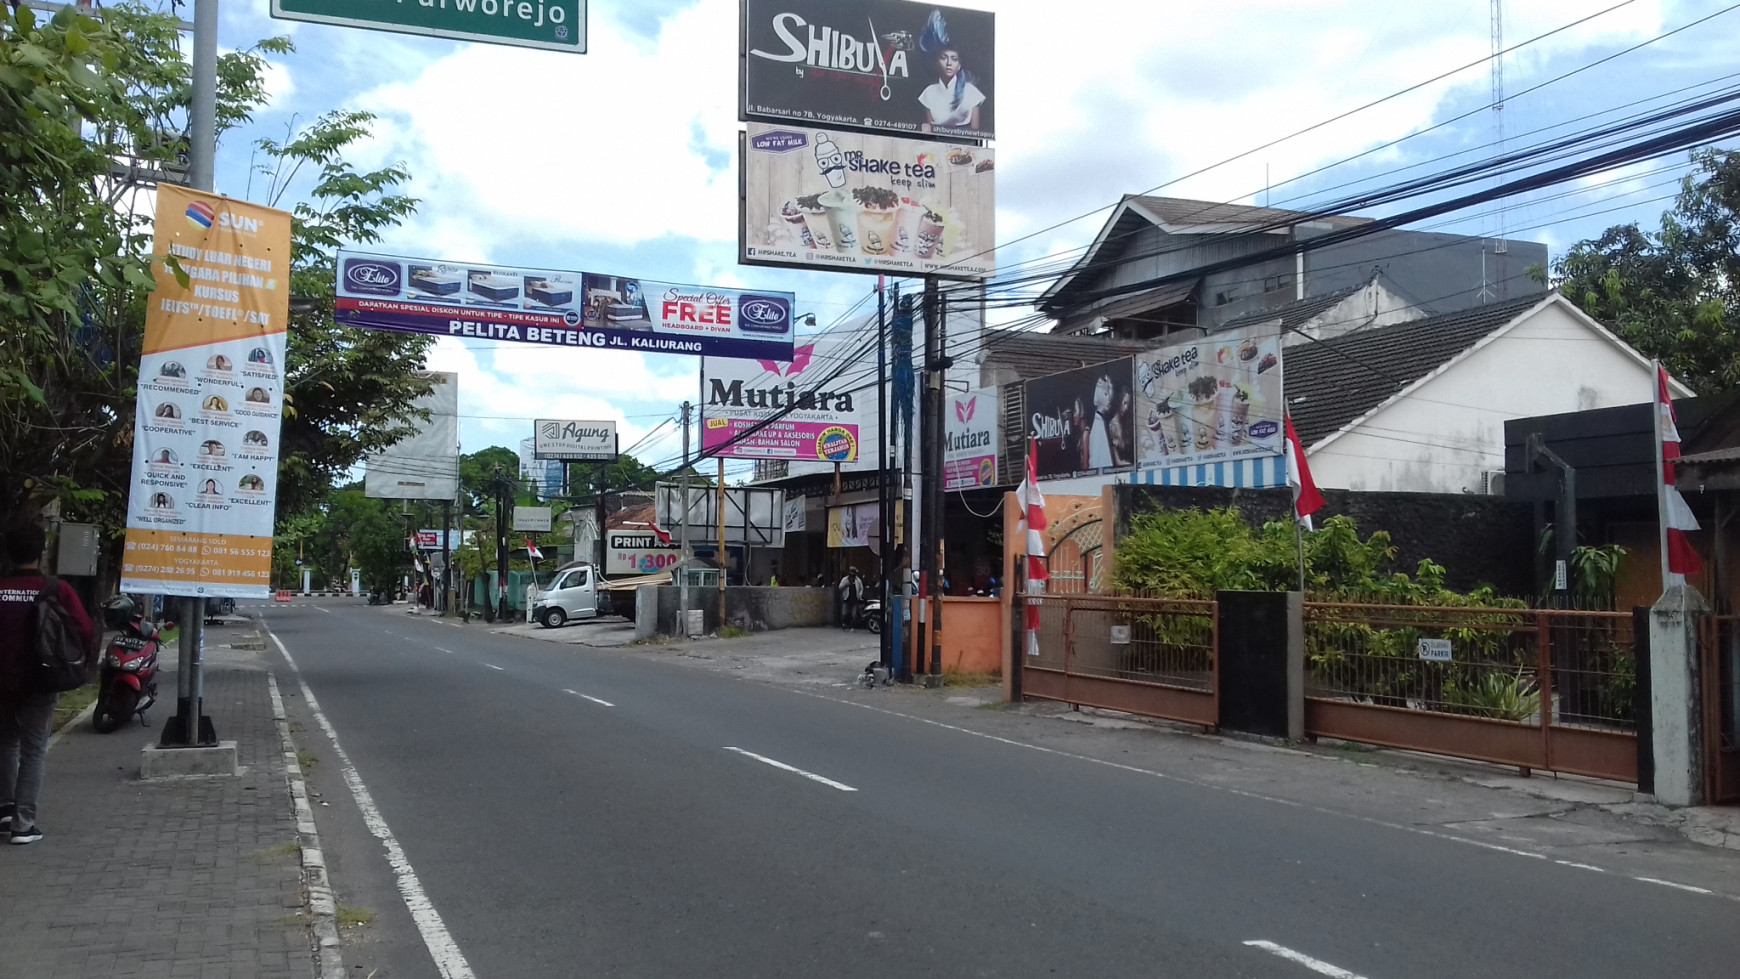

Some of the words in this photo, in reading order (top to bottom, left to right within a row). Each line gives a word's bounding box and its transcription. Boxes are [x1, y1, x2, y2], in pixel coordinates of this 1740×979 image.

[796, 66, 804, 78] by
[757, 106, 790, 115] Babarsari
[904, 163, 936, 179] tea
[890, 175, 912, 191] keep
[917, 178, 936, 189] slim
[204, 250, 232, 266] LUAR
[234, 254, 272, 273] NEGERI
[355, 266, 390, 284] Elite
[194, 285, 239, 303] KURSUS
[663, 287, 705, 303] Special
[359, 301, 399, 310] DAPATKAN
[401, 304, 429, 313] SPESIAL
[432, 307, 459, 315] DISKON
[460, 309, 485, 317] UNTUK
[525, 315, 548, 323] KASUR
[662, 301, 731, 325] FREE
[748, 303, 779, 320] Elite
[662, 323, 704, 331] HEADBOARD
[449, 321, 520, 340] PELITA
[527, 327, 606, 347] BETENG
[609, 336, 627, 347] JL.
[631, 335, 702, 352] KALIURANG
[708, 377, 855, 412] Mutiara
[562, 422, 609, 442] Agung
[784, 431, 815, 440] AKSESORIS
[780, 439, 801, 447] SALON
[614, 537, 652, 547] PRINT
